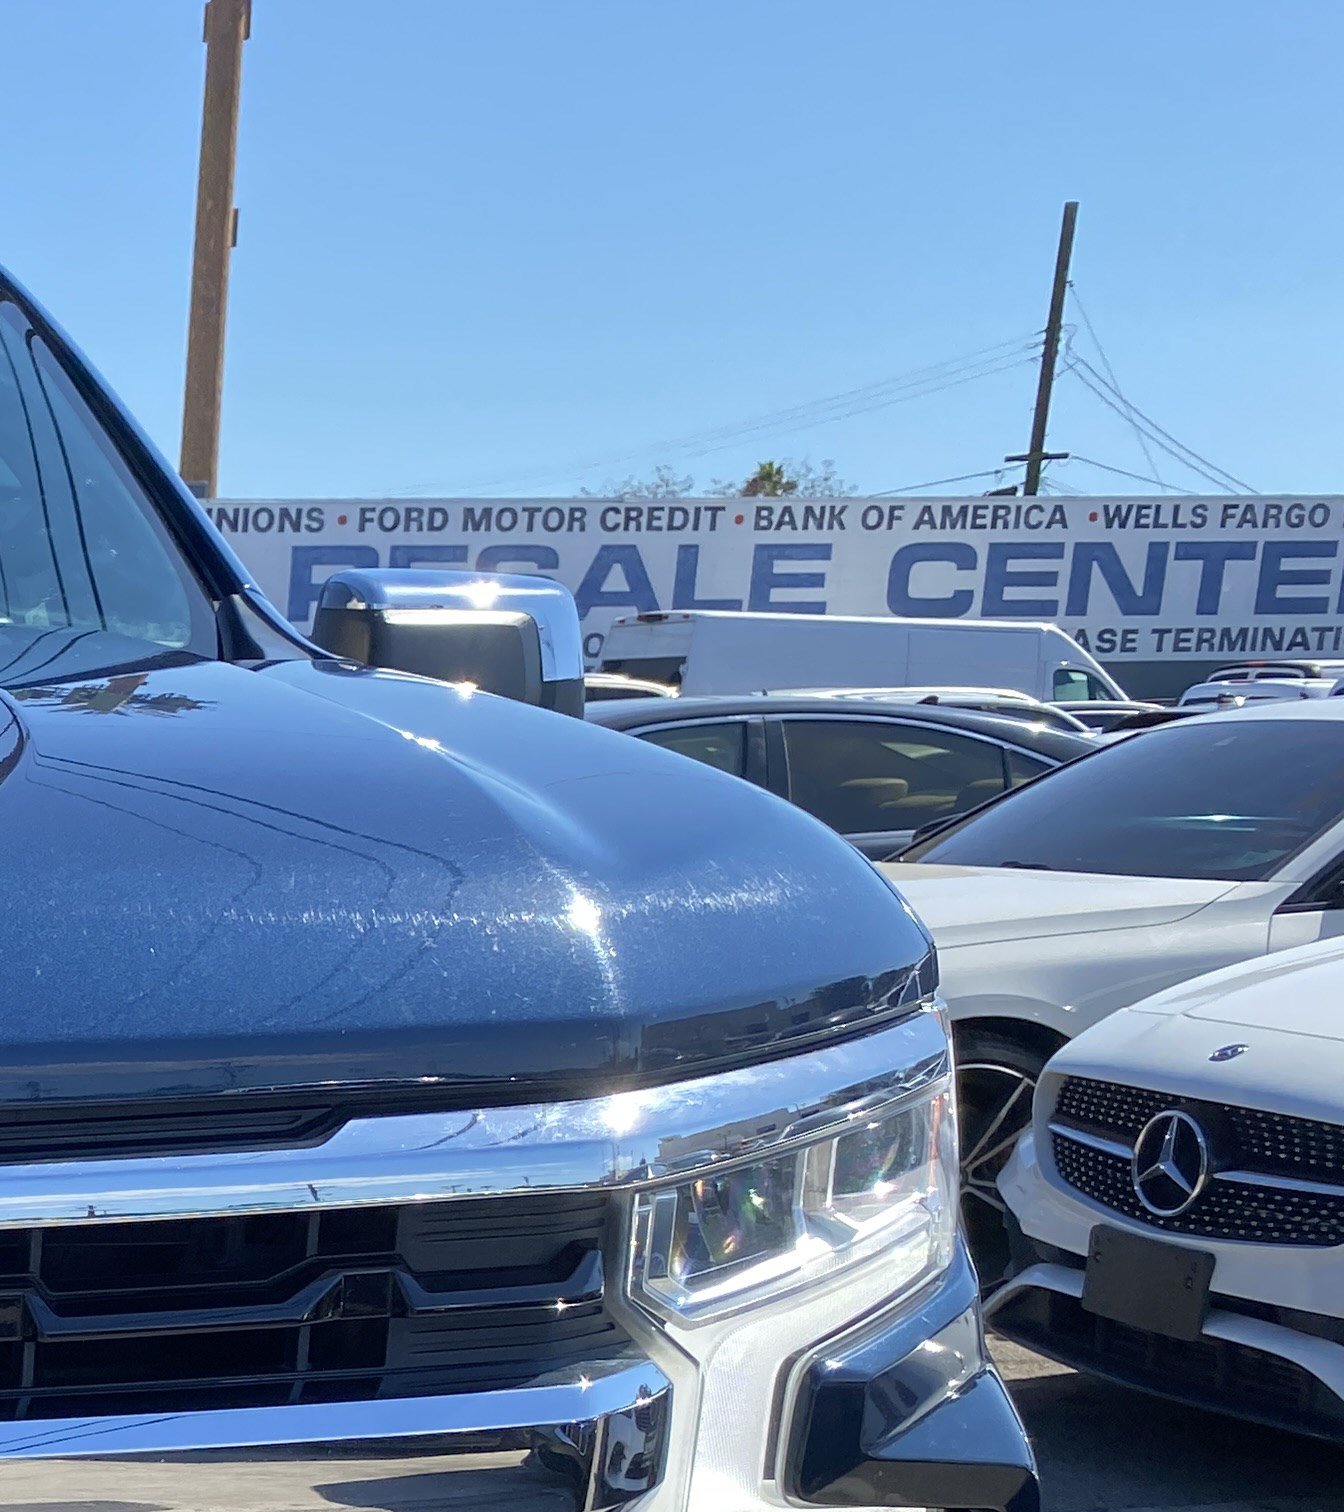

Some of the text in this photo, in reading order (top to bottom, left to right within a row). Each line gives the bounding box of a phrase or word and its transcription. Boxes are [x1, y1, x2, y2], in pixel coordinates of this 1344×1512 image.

[207, 503, 1331, 533] NIONS FORD MOTOR CREDIT BANK OF AMERICA WELLS FARGO
[886, 540, 1344, 618] CENTE
[1061, 628, 1139, 654] ASE
